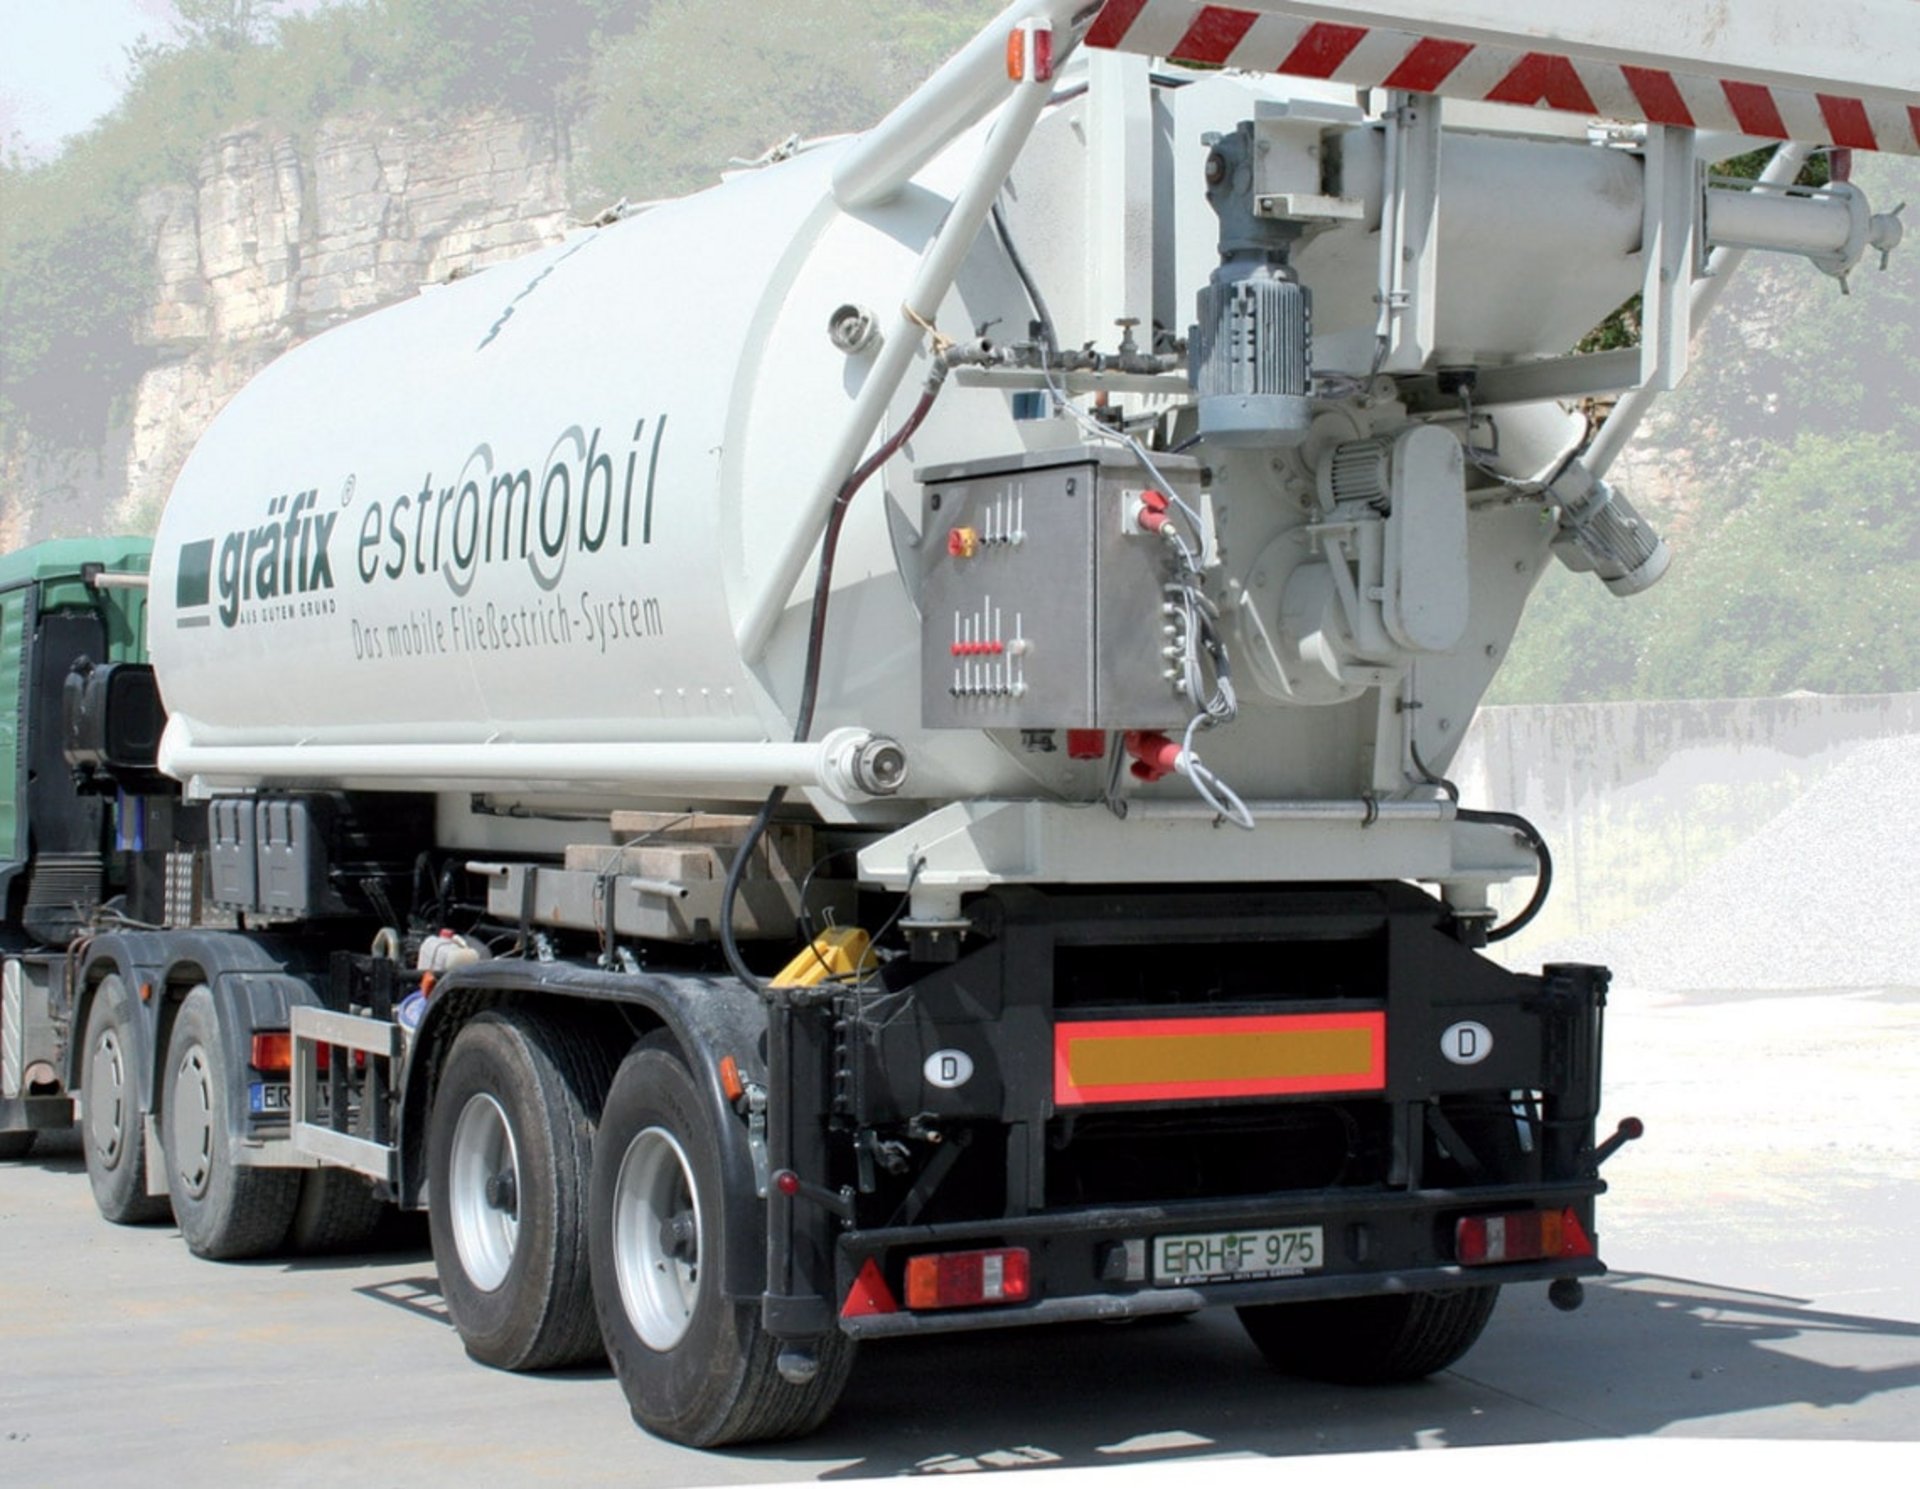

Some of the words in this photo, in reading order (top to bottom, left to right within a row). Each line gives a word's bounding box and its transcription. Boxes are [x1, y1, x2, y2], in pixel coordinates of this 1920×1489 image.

[218, 489, 338, 628] gräfix
[358, 413, 668, 584] estromobil
[300, 598, 336, 618] GRUND
[352, 618, 383, 660] Das
[387, 608, 447, 657] mobile
[450, 591, 664, 653] Fließestrich-System
[1458, 1028, 1476, 1057] D
[941, 1056, 957, 1080] D
[1265, 1232, 1314, 1265] 975
